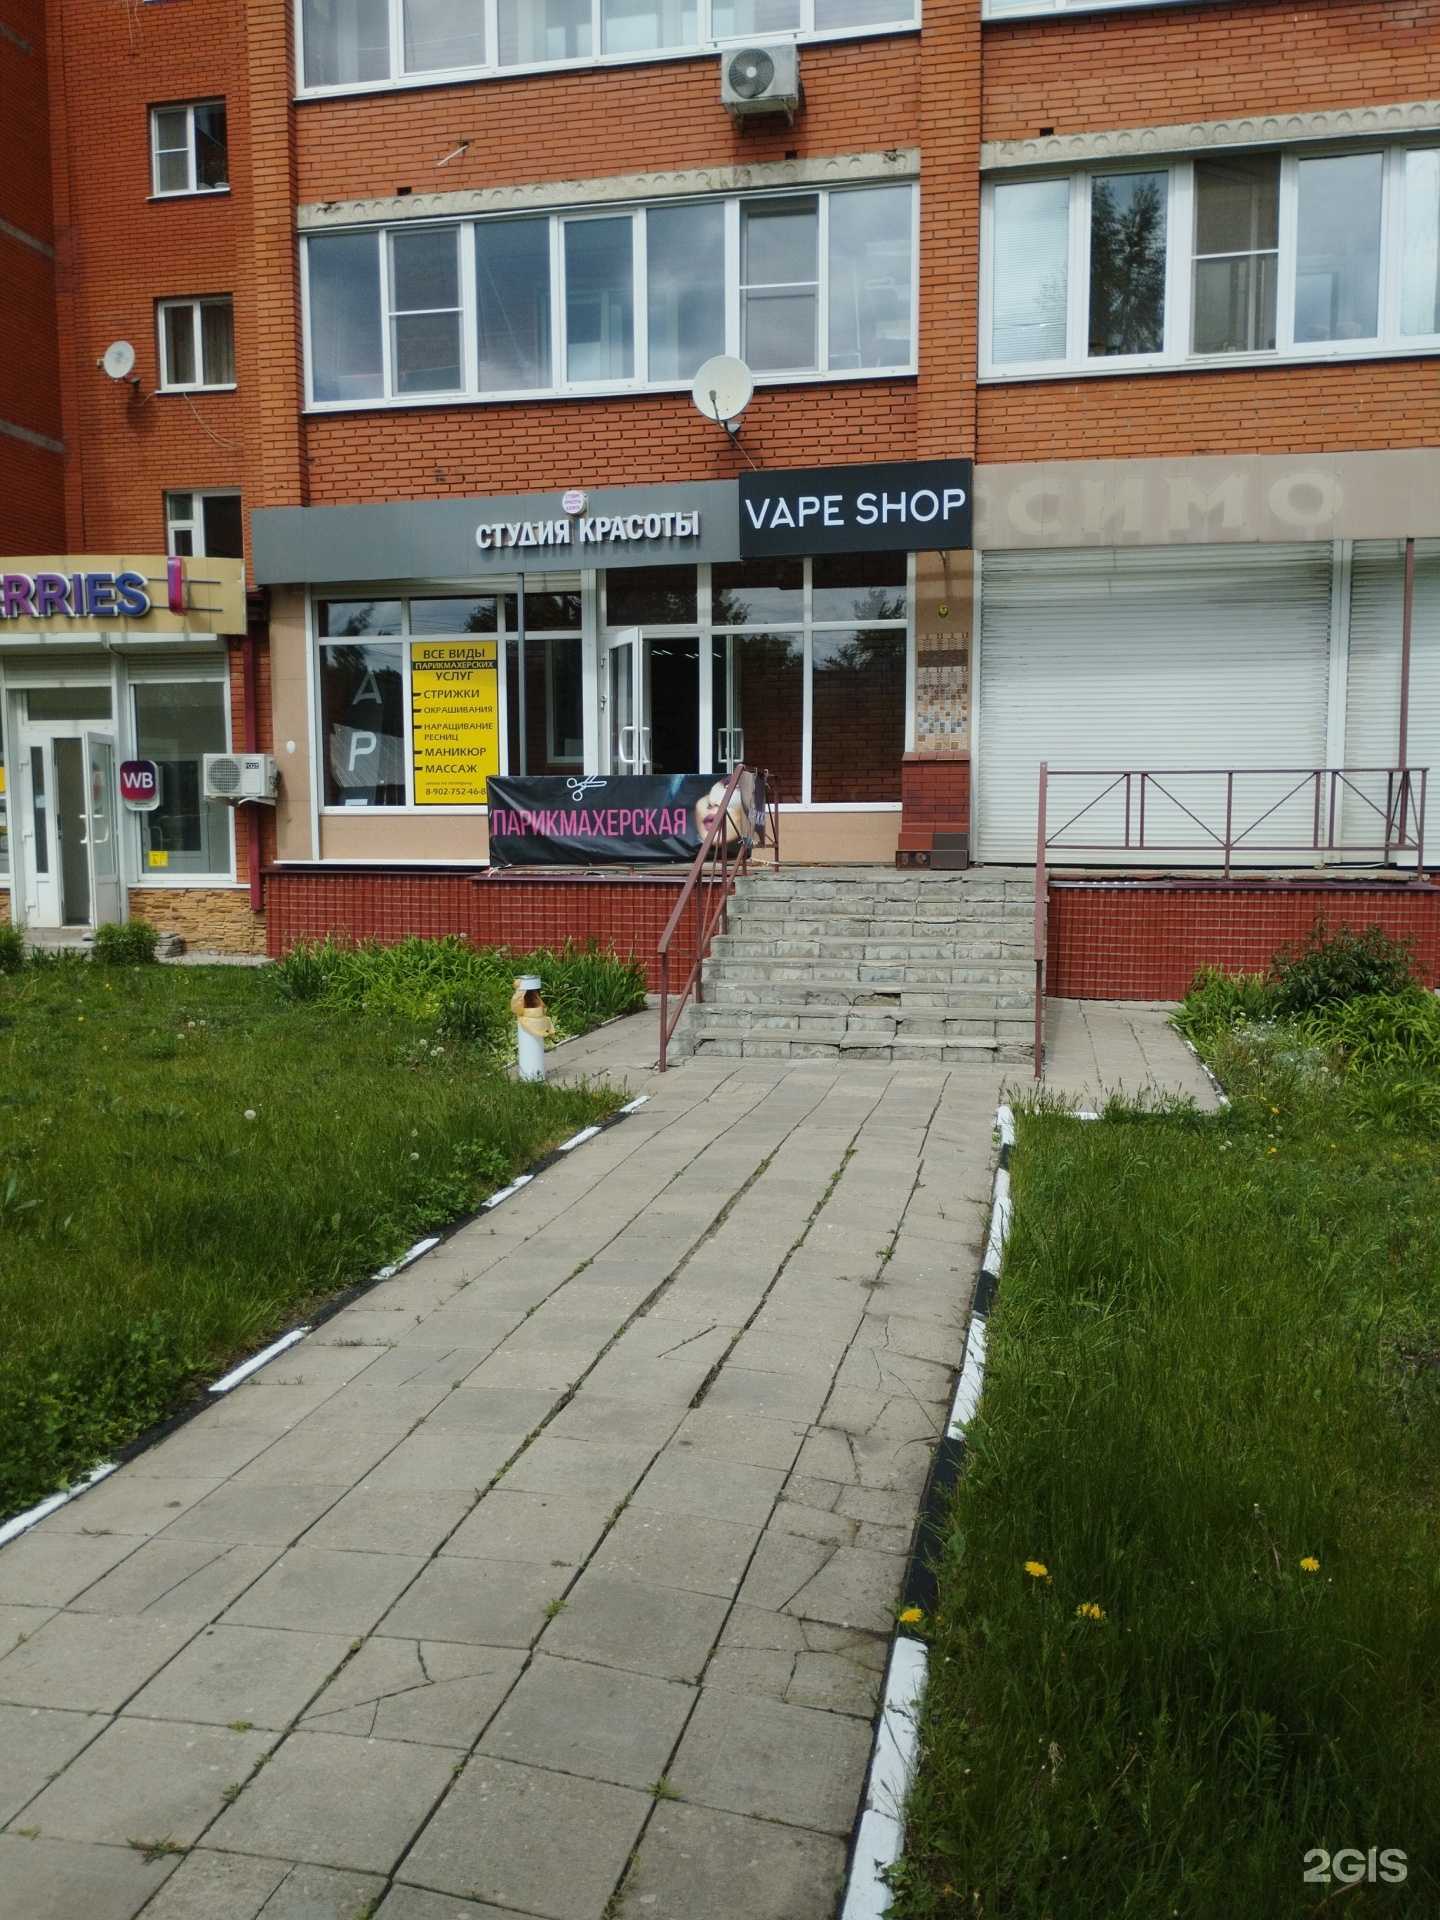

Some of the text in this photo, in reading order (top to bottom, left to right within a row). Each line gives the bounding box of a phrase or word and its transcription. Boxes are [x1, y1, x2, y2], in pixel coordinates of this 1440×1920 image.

[745, 488, 966, 529] VAPE SHOP
[474, 511, 700, 550] СТУДИЯ КРАСОТЫ
[0, 570, 150, 617] RRIES
[423, 648, 486, 660] ВСЕ ВИДЫ
[415, 661, 494, 670] ПАРИКМАХЕРСКИХ
[435, 671, 474, 681] УСЛУГ
[423, 689, 480, 699] СТРИЖКИ
[423, 705, 494, 714] ОКРАШИВАНИЯ
[423, 722, 494, 731] НАРАЩИВАНИЕ
[424, 733, 459, 742] РЕСНИЦ
[425, 747, 487, 757] МАНИКЮР
[425, 764, 478, 774] МАССАЖ
[122, 771, 154, 789] WB
[490, 807, 687, 837] ПАРИКМАХЕРСКАЯ
